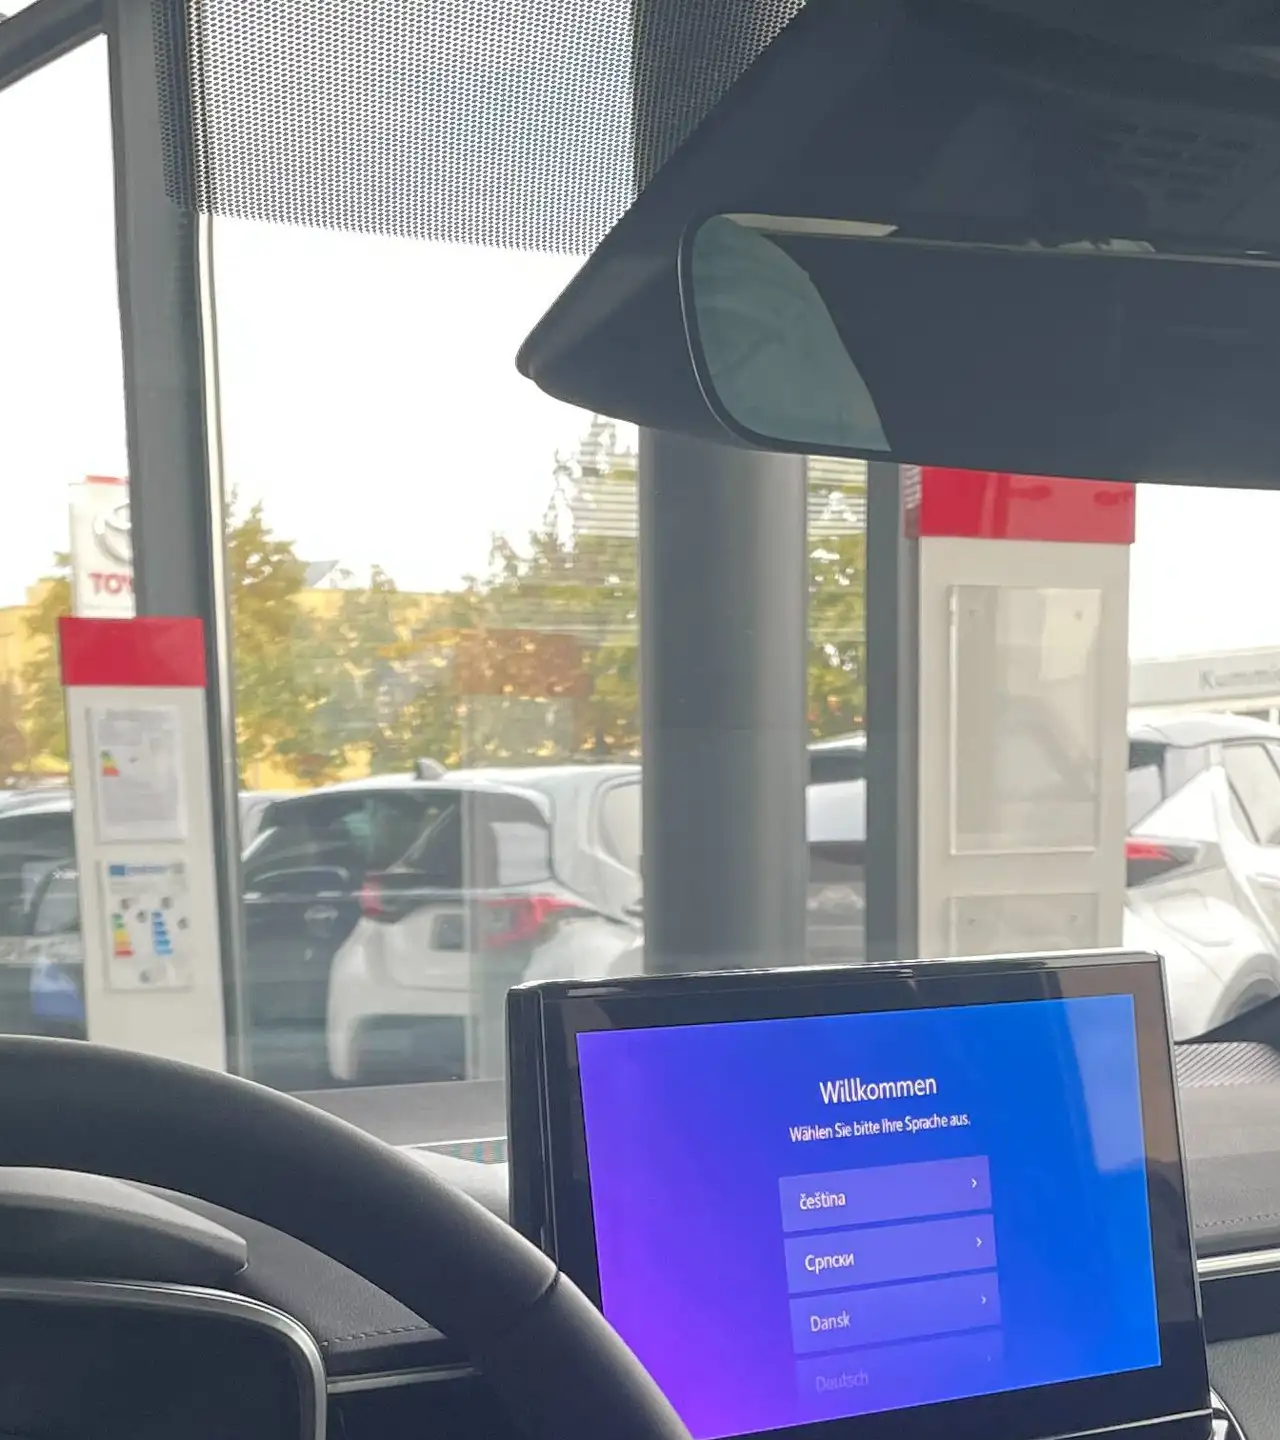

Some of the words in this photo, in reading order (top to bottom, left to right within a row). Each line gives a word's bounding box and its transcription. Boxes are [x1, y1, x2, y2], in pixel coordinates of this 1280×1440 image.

[819, 1077, 937, 1104] Willkommen
[789, 1125, 833, 1142] Wählen
[835, 1122, 852, 1138] Sie
[854, 1120, 880, 1136] bitte
[882, 1118, 903, 1133] Ihre
[905, 1114, 947, 1134] Sprache
[949, 1114, 971, 1127] aus.
[800, 1191, 846, 1210] čeština
[805, 1253, 855, 1274] Српски
[810, 1310, 850, 1331] Dansk
[815, 1370, 869, 1392] Deutsch
